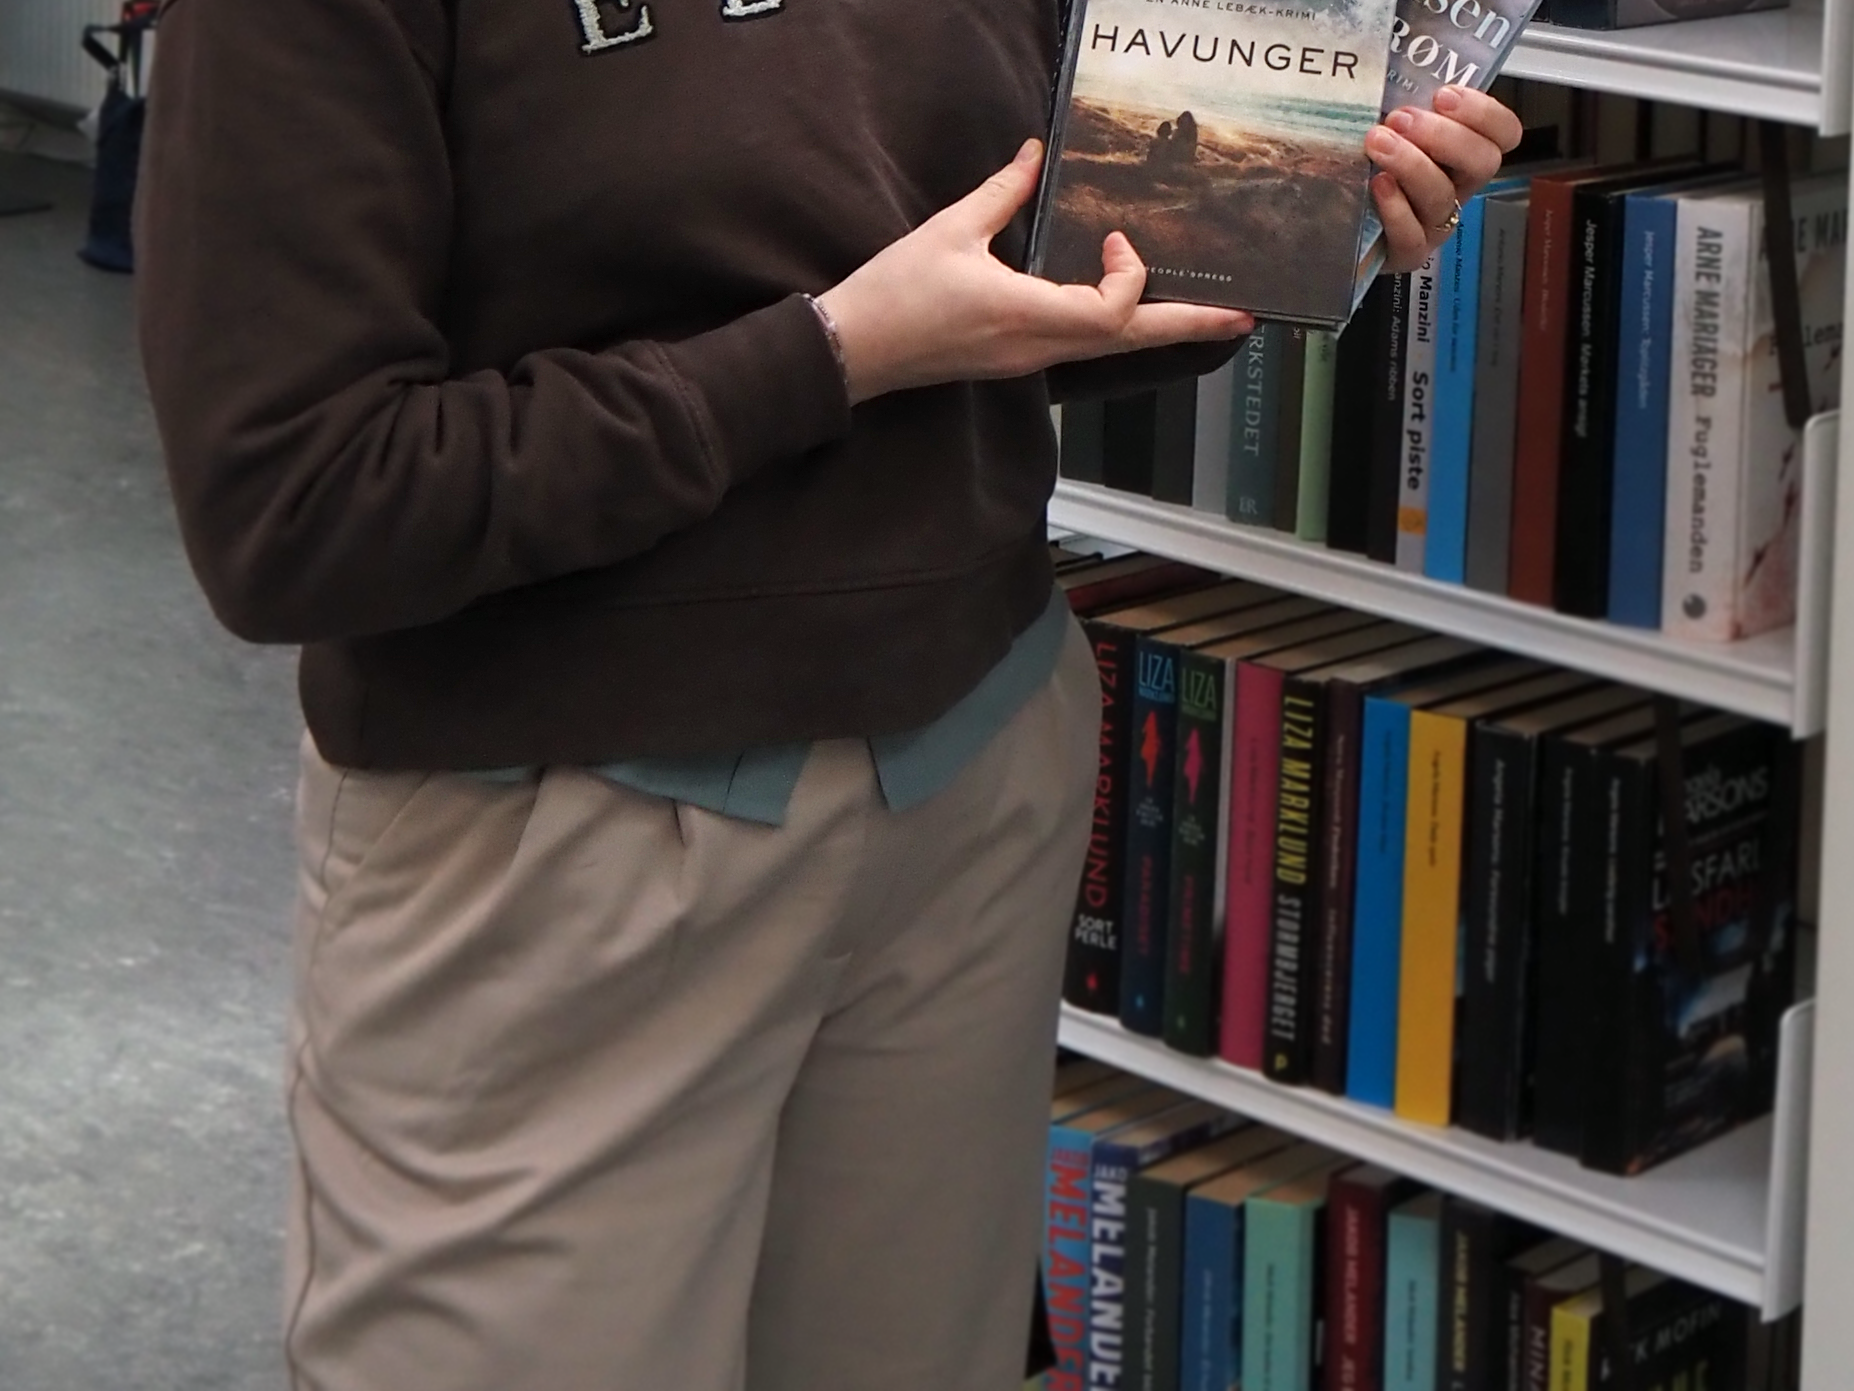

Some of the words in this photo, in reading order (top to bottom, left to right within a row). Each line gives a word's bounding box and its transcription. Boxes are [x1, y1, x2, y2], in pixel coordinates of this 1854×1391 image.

[1216, 0, 1317, 22] LEBÆK-KRIMI
[1090, 23, 1360, 80] HAVUNGER
[1583, 219, 1598, 264] Jesper
[1640, 229, 1657, 268] Jesper
[1694, 225, 1724, 286] ARNE
[1416, 275, 1434, 344] Manzini
[1638, 270, 1655, 337] Marcussen:
[1389, 315, 1402, 358] Adams
[1688, 288, 1721, 399] MARIAGER
[1386, 360, 1400, 401] ribben
[1411, 371, 1431, 430] Sort
[1405, 430, 1426, 492] piste
[1687, 416, 1713, 574] Fuglemanden
[1137, 649, 1176, 693] LIZA
[1181, 664, 1219, 709] LIZA
[1282, 695, 1314, 749] LIZA
[1276, 757, 1312, 885] MARKLUND
[1074, 925, 1118, 951] PERLE
[1077, 912, 1114, 938] SORT
[1270, 893, 1302, 1042] STORMBJERGET
